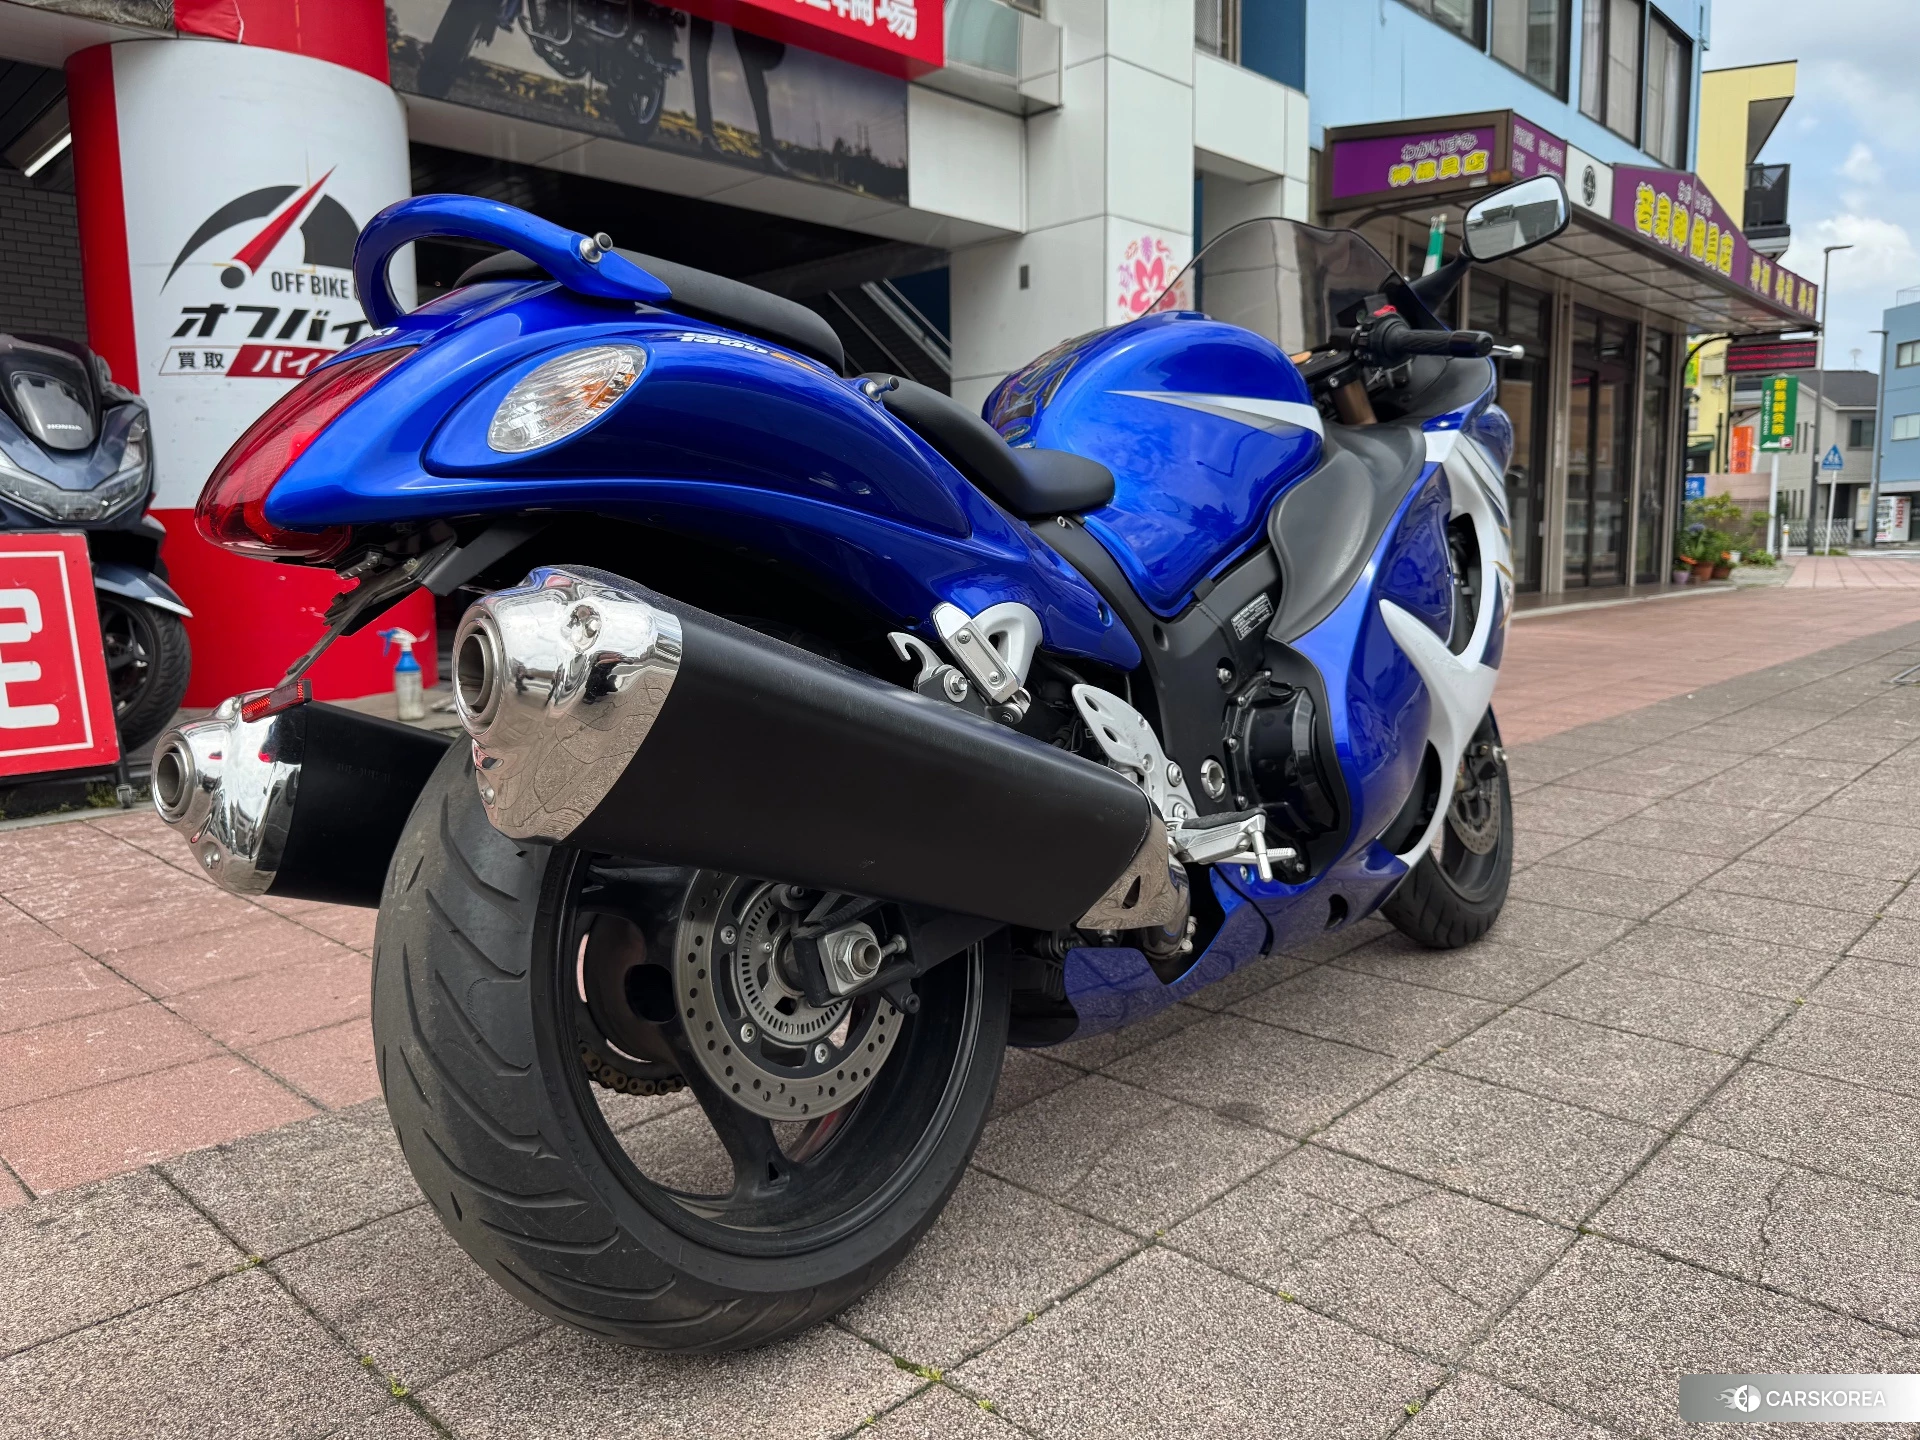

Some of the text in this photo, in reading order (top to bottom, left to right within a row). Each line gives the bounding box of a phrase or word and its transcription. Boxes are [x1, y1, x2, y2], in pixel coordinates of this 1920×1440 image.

[271, 271, 304, 293] OFF
[310, 275, 350, 299] BIKE
[178, 351, 225, 370] 買取
[1896, 498, 1905, 529] KIRIN
